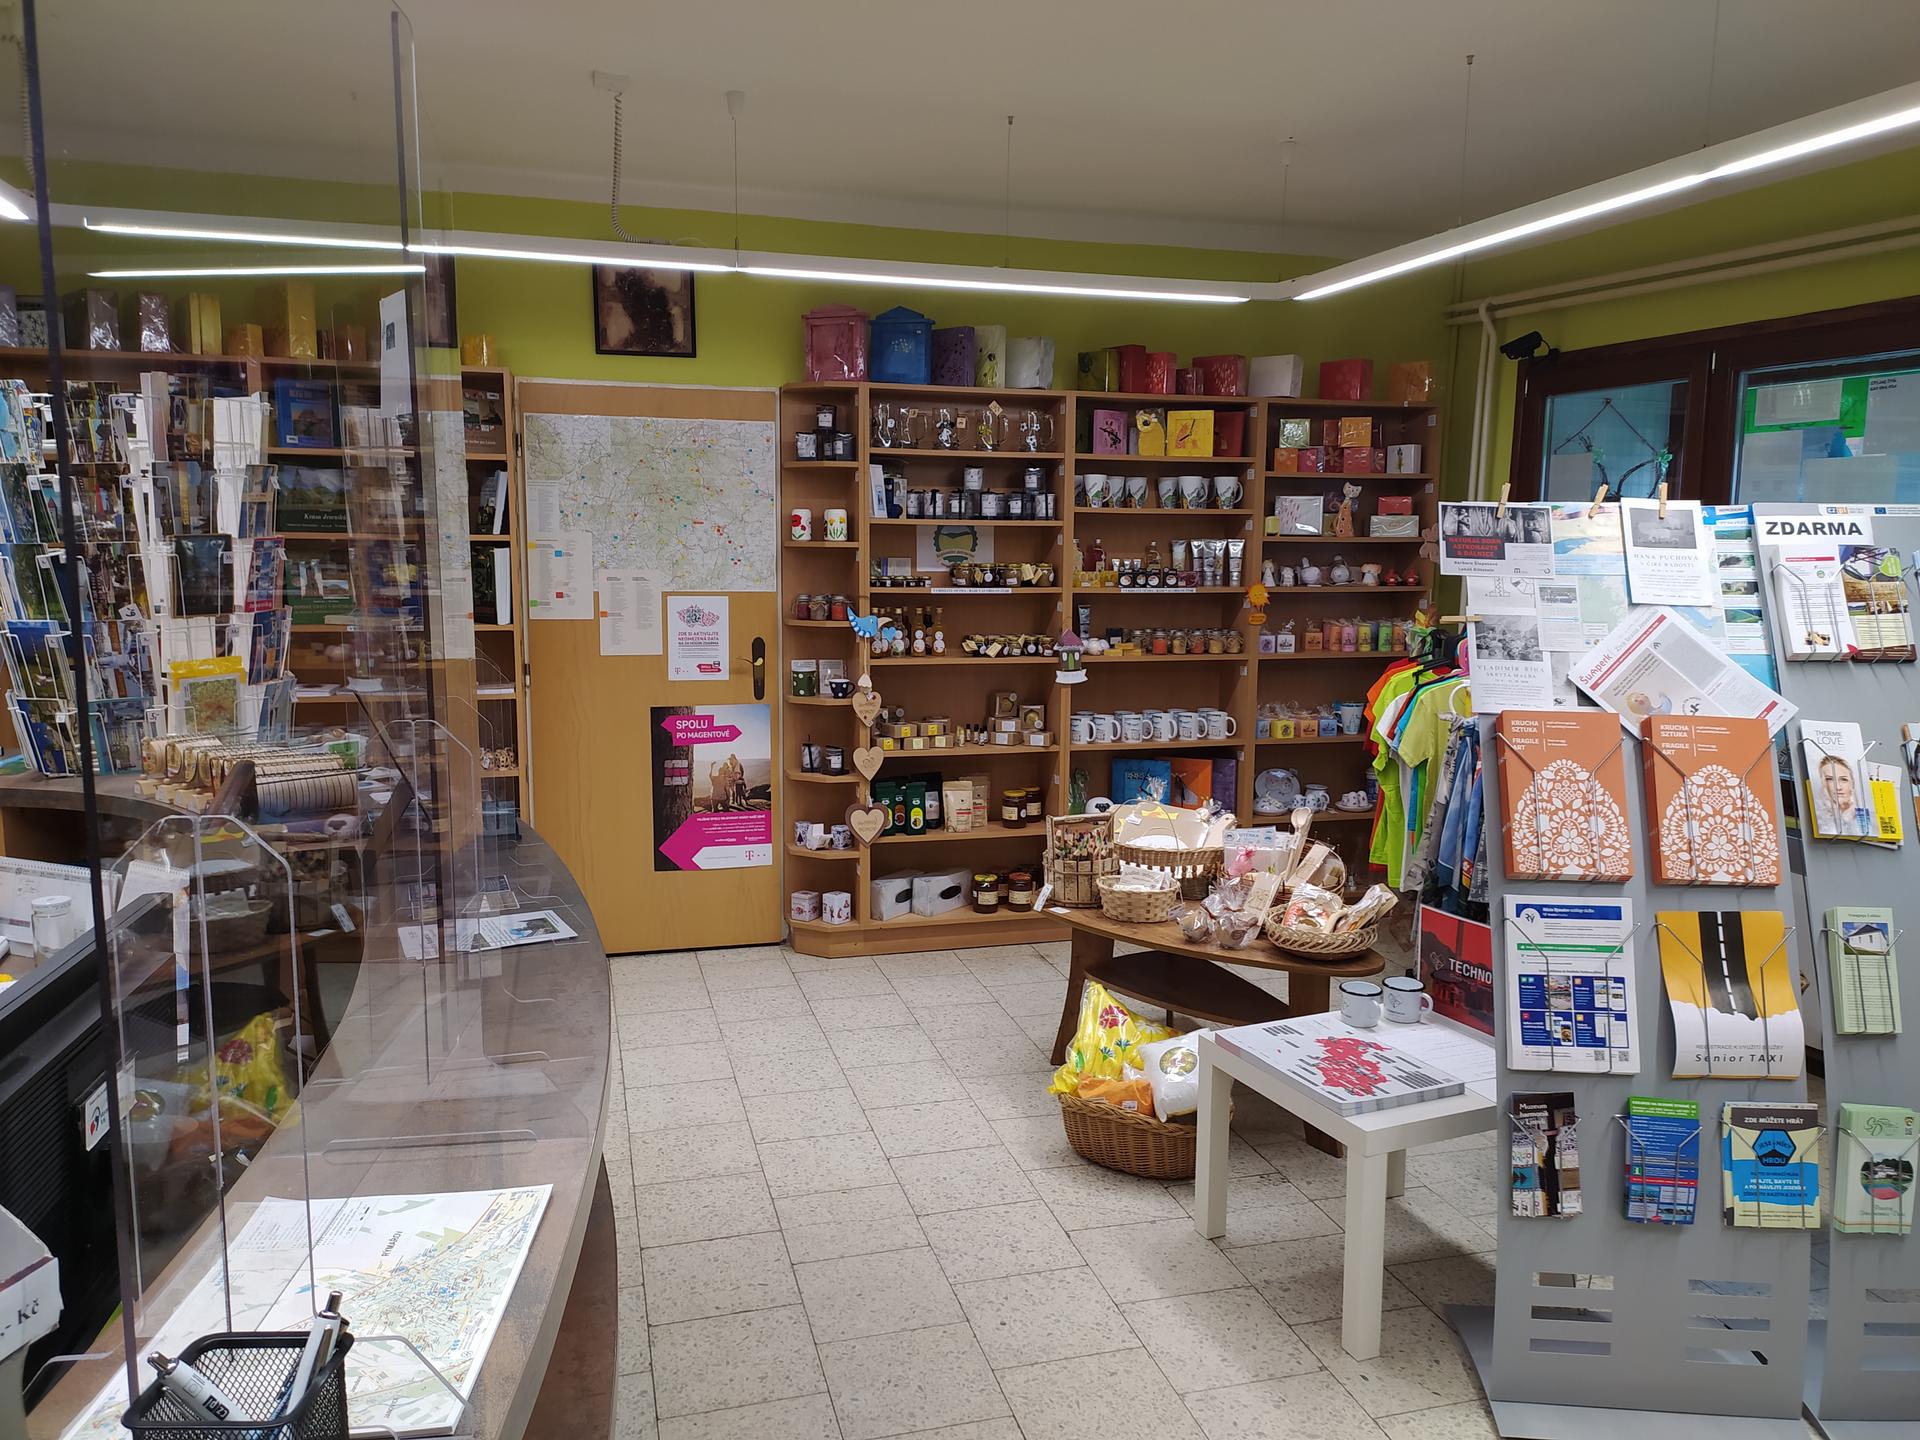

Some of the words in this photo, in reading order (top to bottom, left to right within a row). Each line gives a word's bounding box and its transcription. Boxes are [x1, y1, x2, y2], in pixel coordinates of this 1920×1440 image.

[1764, 520, 1864, 536] ZDARMA
[1578, 652, 1613, 685] Šumperk
[675, 719, 708, 730] SPOLU
[1511, 719, 1539, 727] KRUCHA
[687, 729, 730, 738] MAGENTOVÉ
[1512, 737, 1540, 745] FRAGILE
[1816, 736, 1846, 746] LOVE
[1448, 957, 1493, 985] TECHNO
[1695, 1053, 1749, 1063] Senior
[1749, 1053, 1784, 1063] TAXI
[1758, 1115, 1785, 1124] MŮŽETE
[1785, 1116, 1804, 1125] HRÁT
[17, 1298, 39, 1325] Kč
